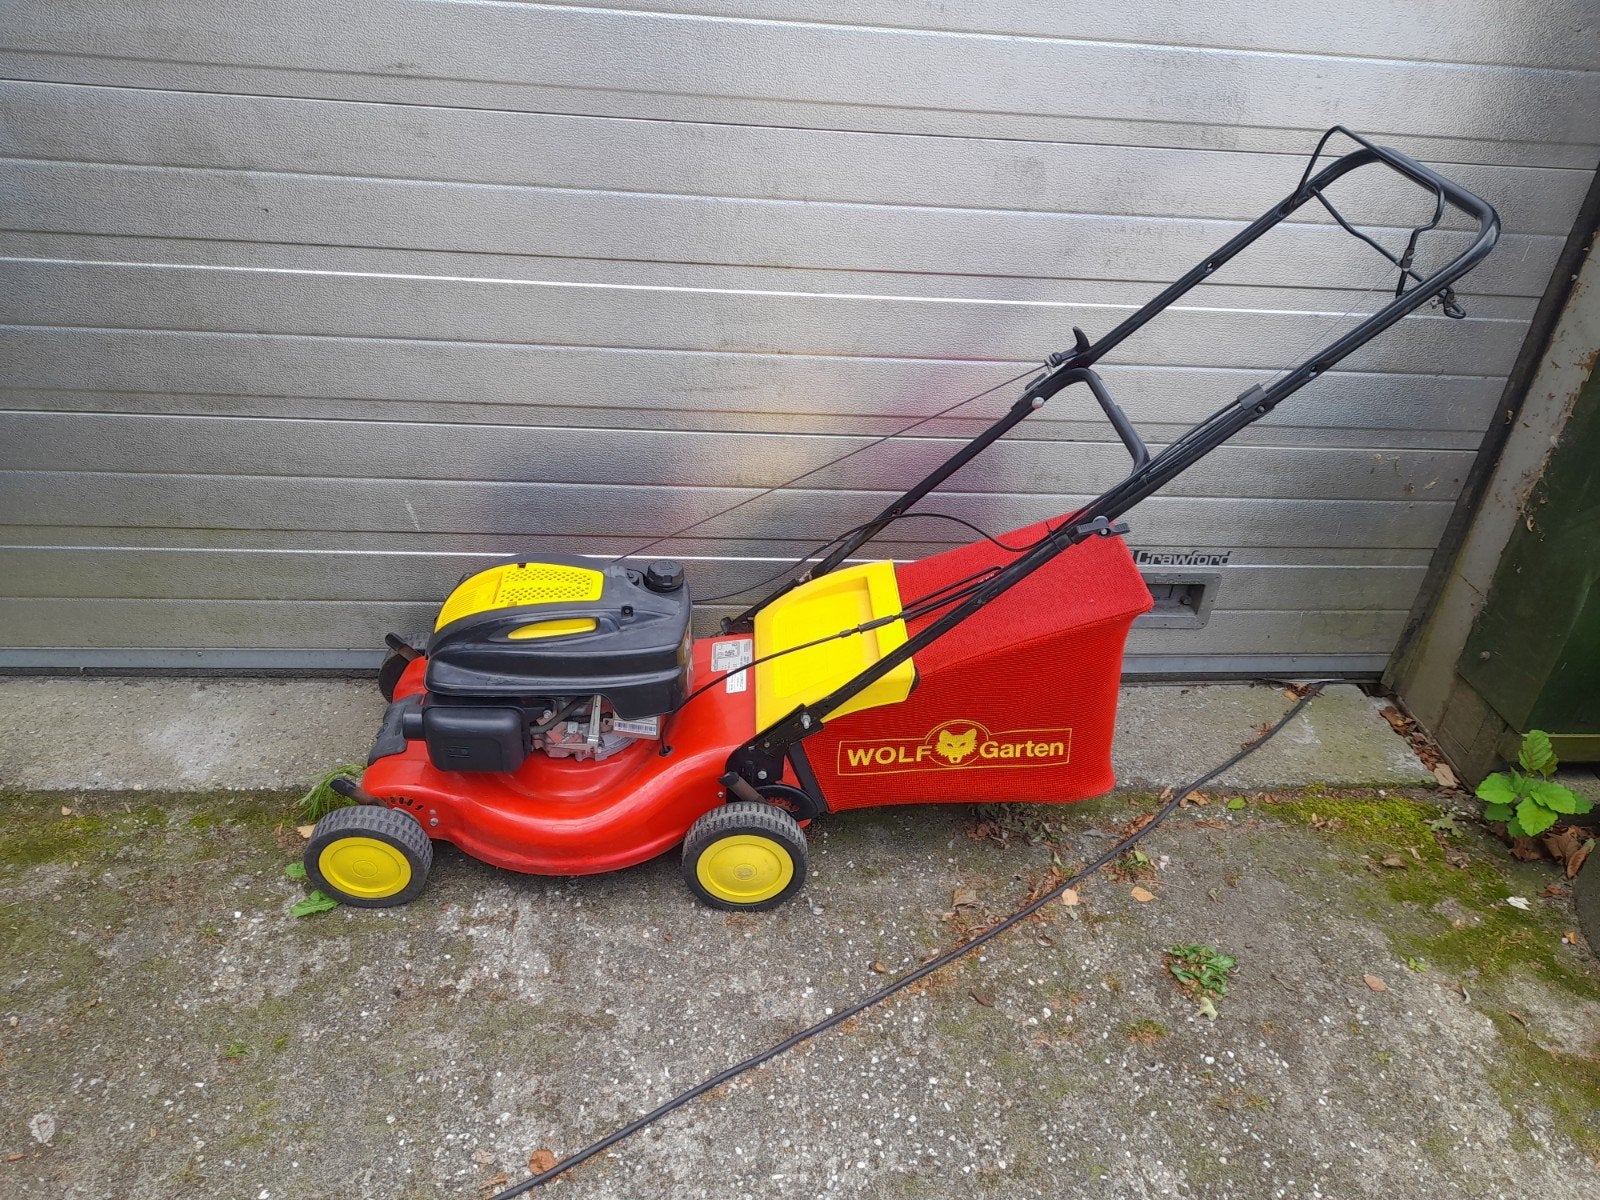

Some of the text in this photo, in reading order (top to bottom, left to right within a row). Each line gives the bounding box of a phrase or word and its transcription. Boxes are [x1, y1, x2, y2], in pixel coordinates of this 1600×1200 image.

[1136, 549, 1232, 565] Crawford
[847, 740, 1064, 767] WOLF Garten
